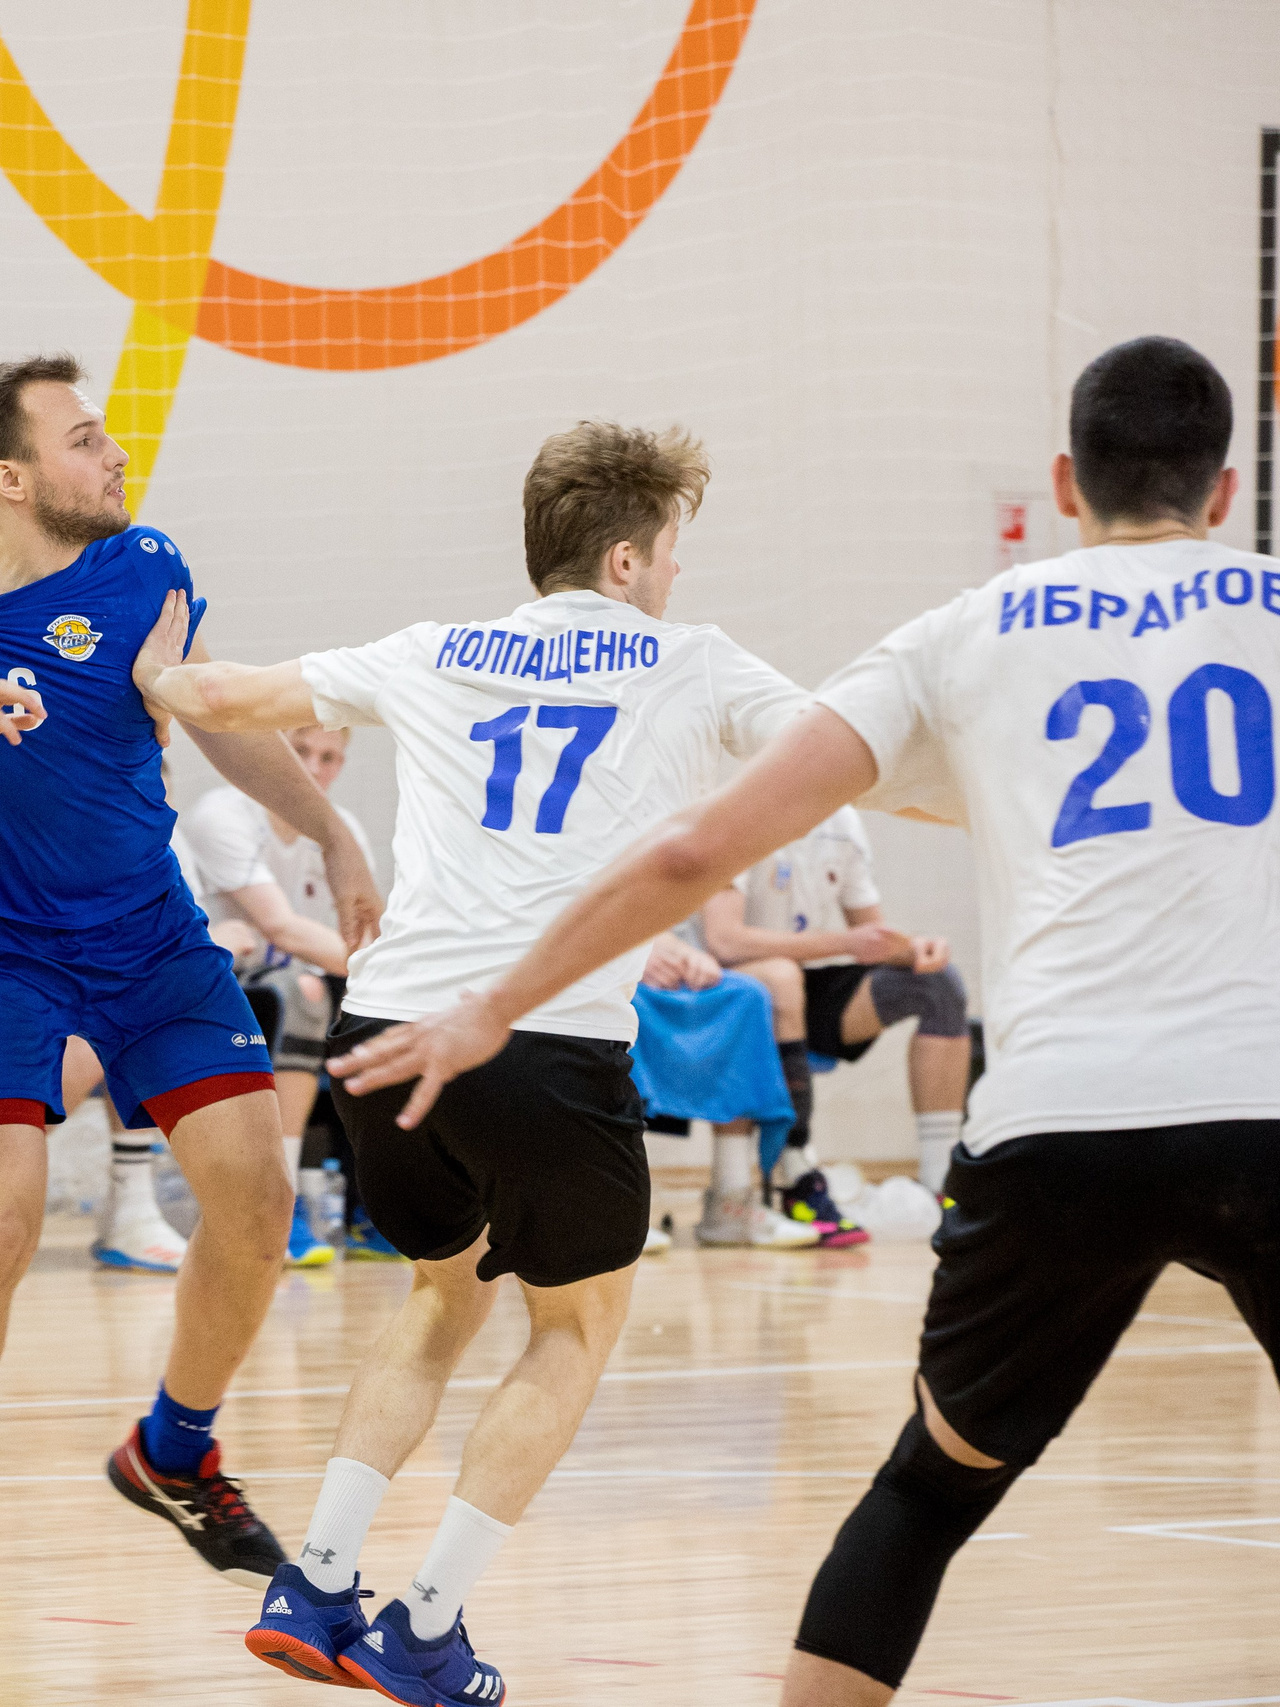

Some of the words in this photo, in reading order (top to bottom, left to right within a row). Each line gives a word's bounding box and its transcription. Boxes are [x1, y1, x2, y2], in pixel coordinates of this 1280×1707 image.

[436, 628, 659, 684] КОЛПАЩЕНКО
[469, 705, 618, 834] 17
[1045, 662, 1276, 849] 20
[249, 1034, 267, 1045] JAK
[265, 1606, 293, 1615] adidas
